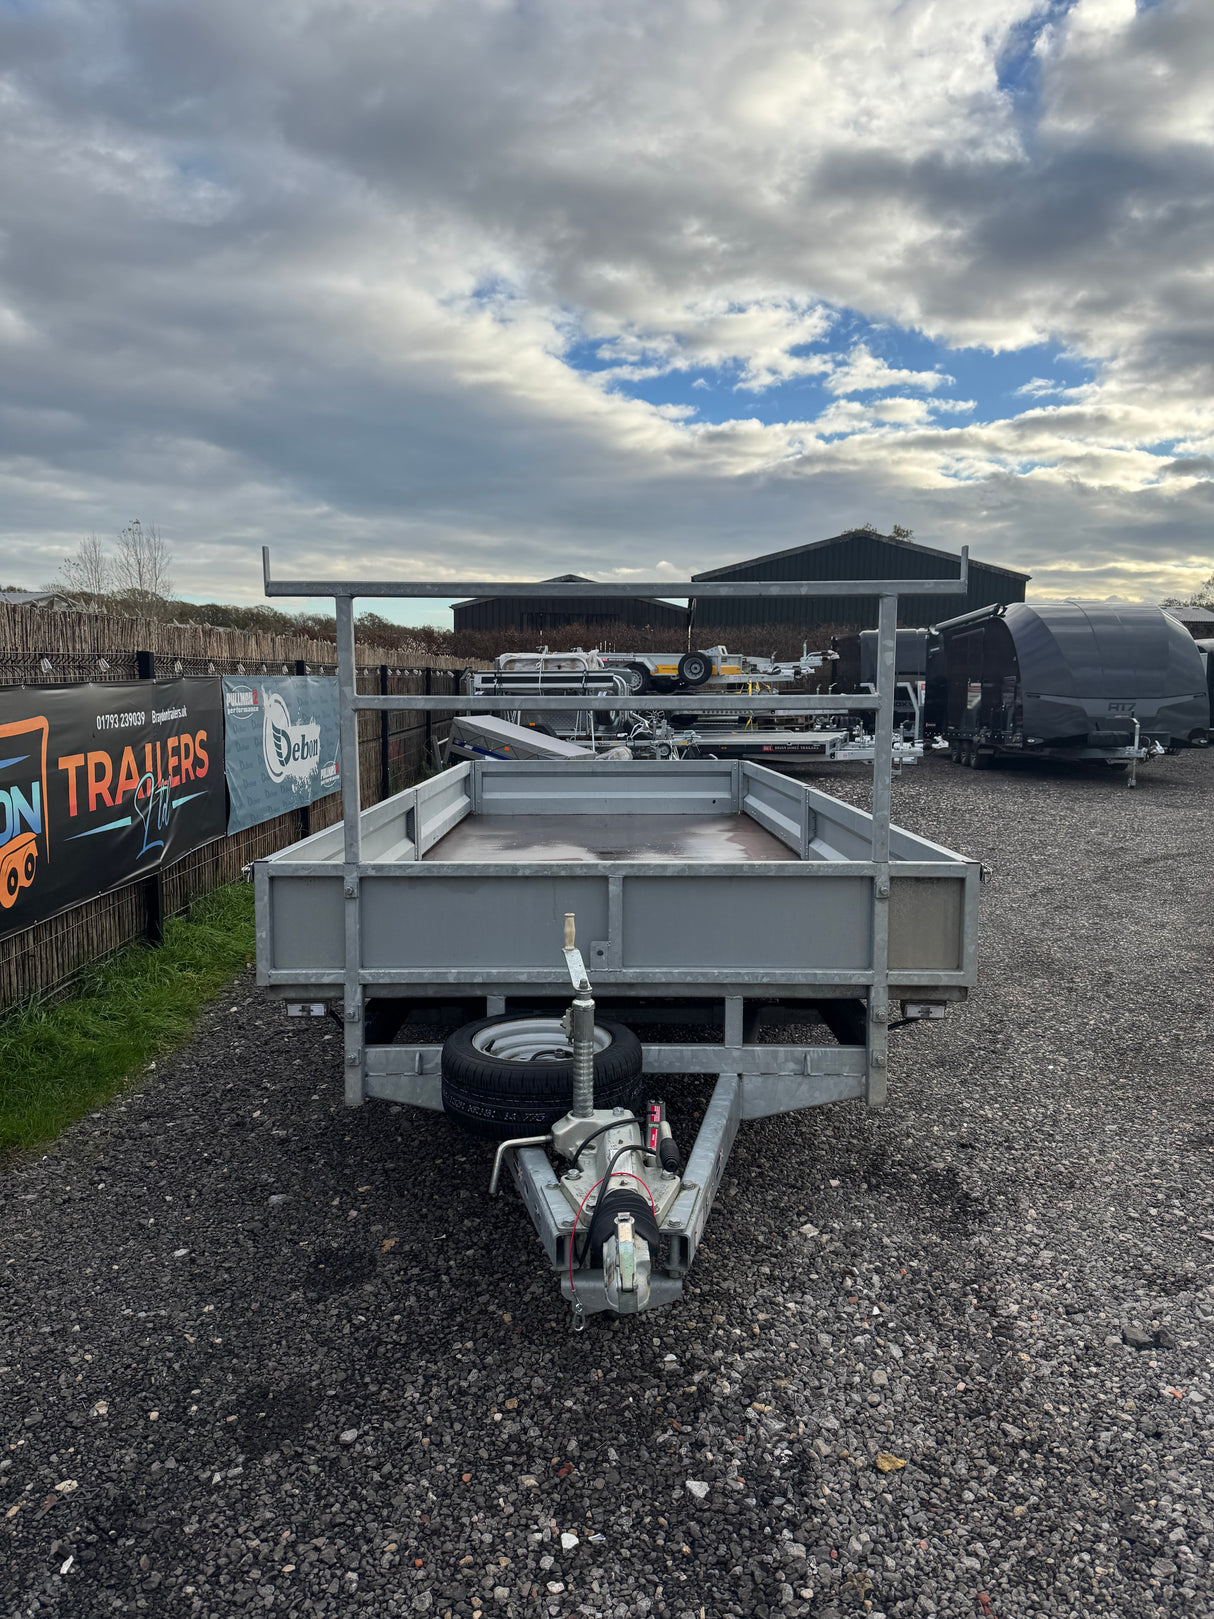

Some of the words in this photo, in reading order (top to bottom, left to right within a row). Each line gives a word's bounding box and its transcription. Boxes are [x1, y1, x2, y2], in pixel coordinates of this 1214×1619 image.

[96, 714, 119, 730] 01793
[120, 711, 145, 728] 239039
[151, 705, 188, 725] Braydontrailers.uk
[227, 706, 260, 715] performance
[271, 721, 319, 768] Debon
[58, 729, 209, 818] TRAILERS
[134, 771, 172, 861] Ltd
